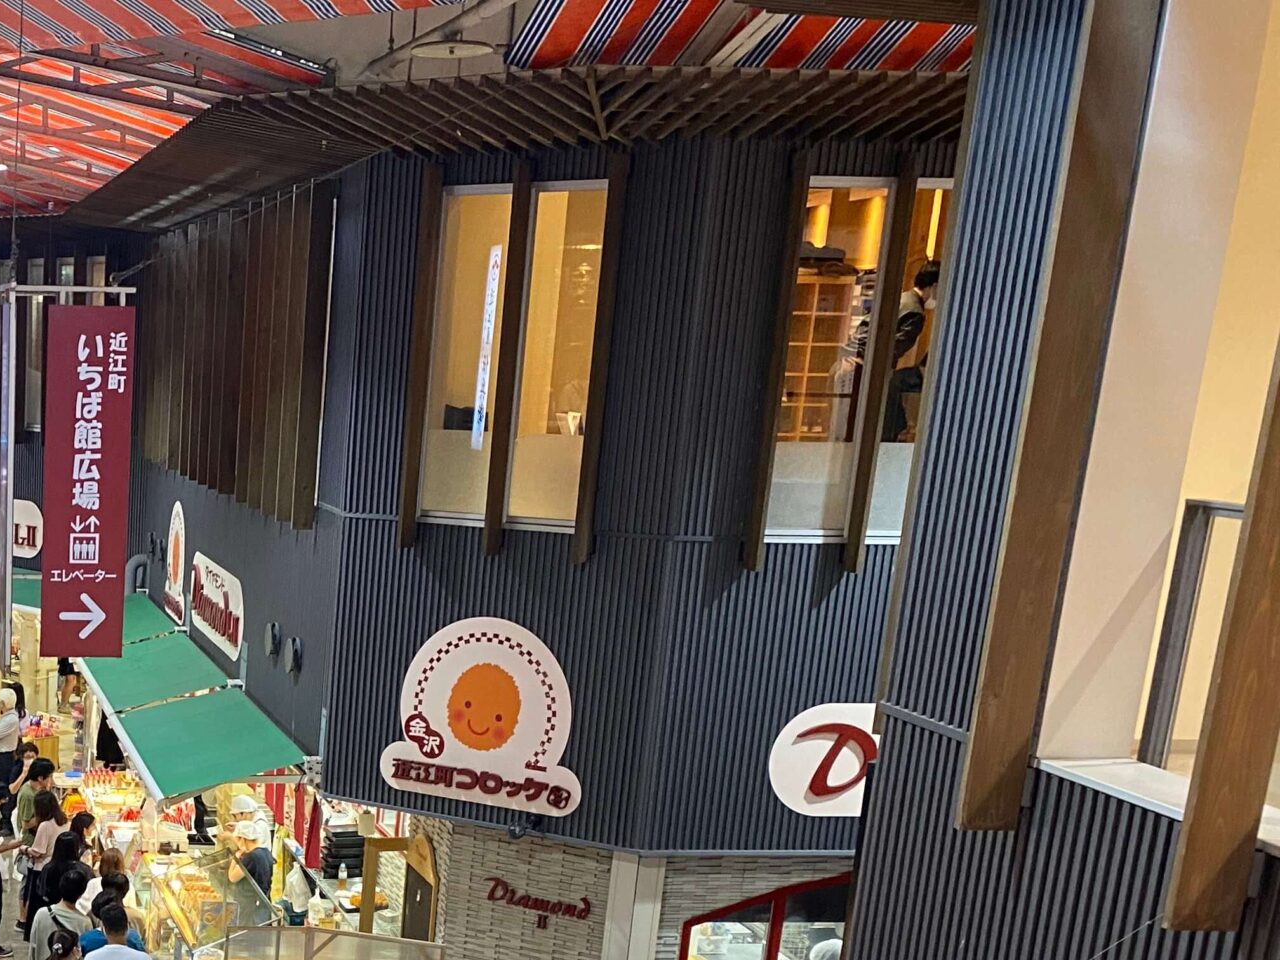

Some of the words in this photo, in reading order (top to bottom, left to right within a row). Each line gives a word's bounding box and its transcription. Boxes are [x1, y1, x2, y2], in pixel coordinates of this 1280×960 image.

[107, 331, 128, 394] 近江町
[72, 334, 104, 511] いちば館広場
[50, 569, 117, 583] エレベーター
[408, 718, 441, 755] 金沢
[391, 758, 550, 802] 近江町コロッケ
[483, 877, 591, 920] Diamond
